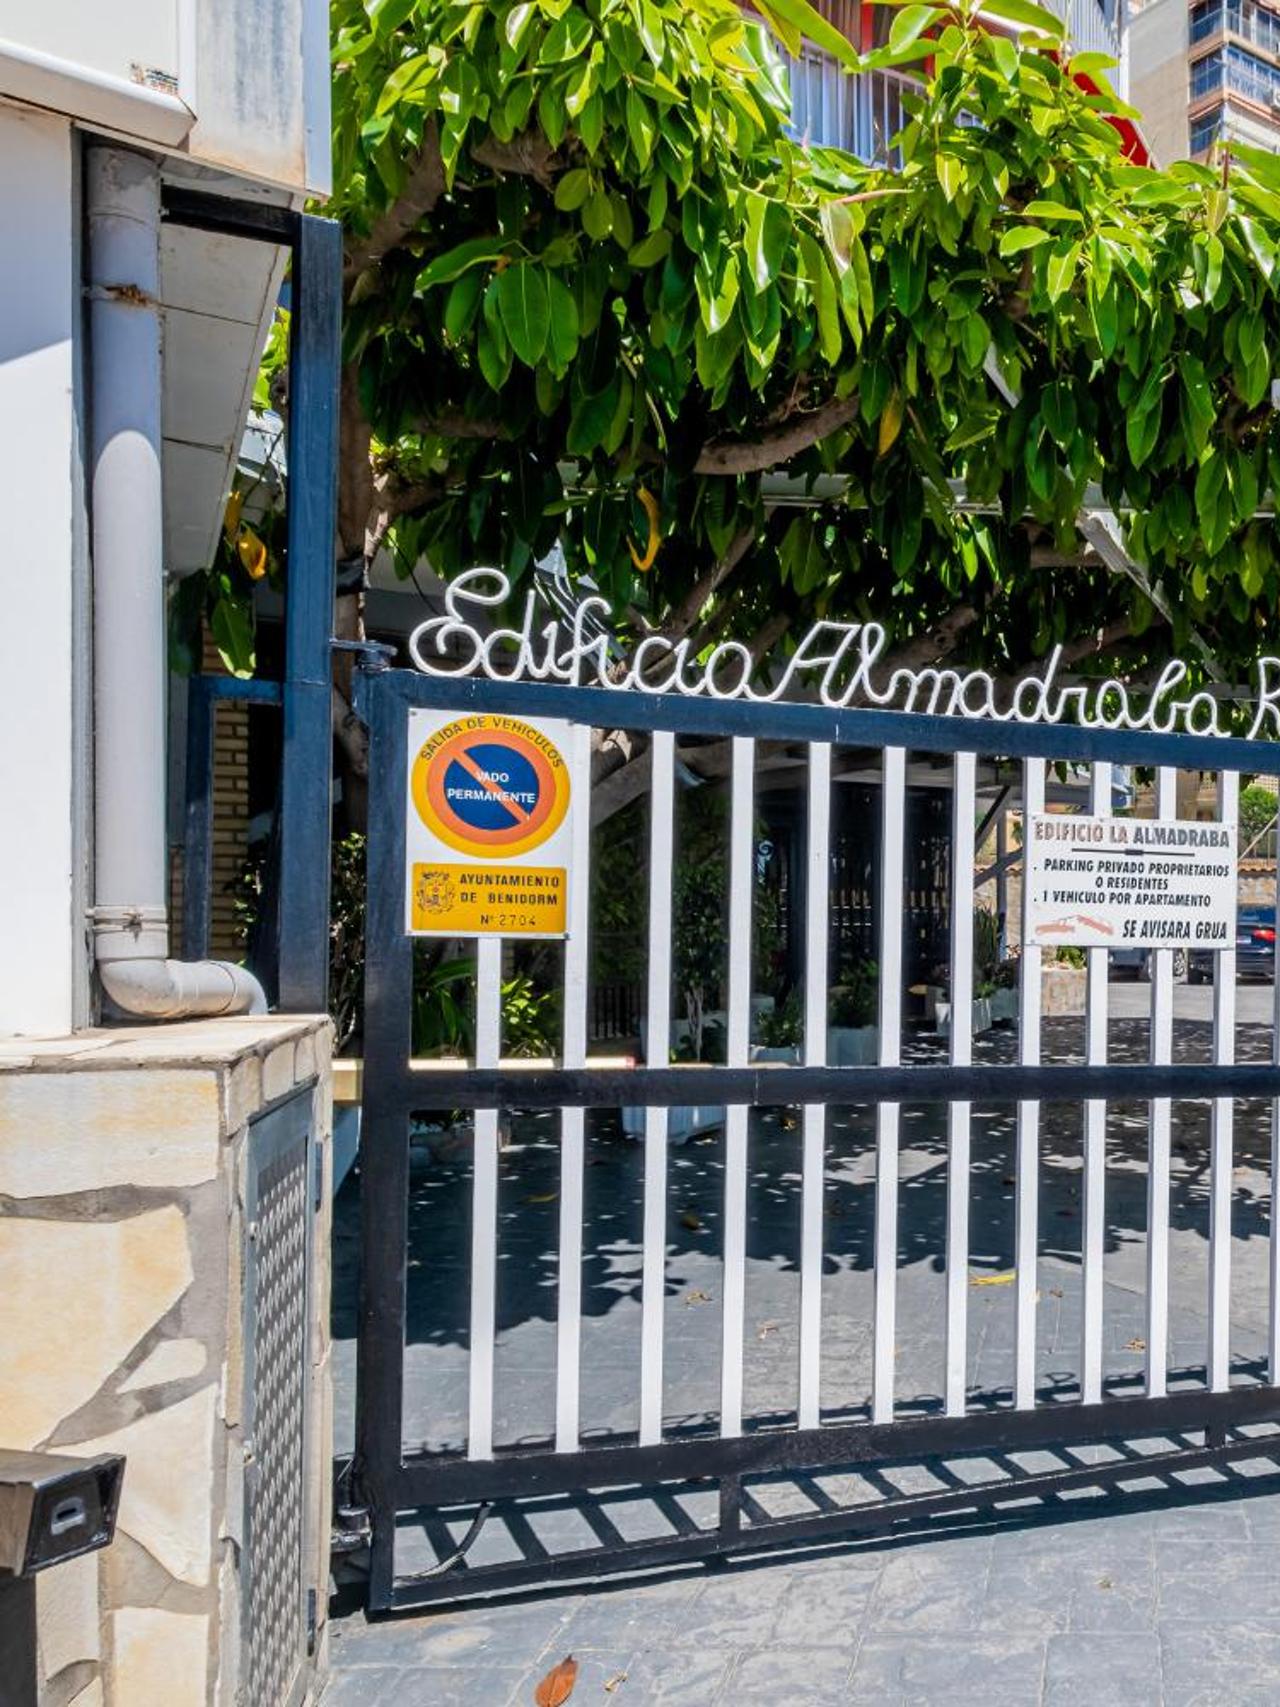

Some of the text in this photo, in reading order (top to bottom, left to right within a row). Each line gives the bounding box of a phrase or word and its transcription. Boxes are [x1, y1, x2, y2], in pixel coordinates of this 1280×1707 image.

[408, 567, 754, 700] Edificio
[750, 620, 1231, 737] Almadraba
[421, 716, 564, 768] SALIDA DE VEHICULOS
[476, 771, 510, 783] VADO
[447, 788, 536, 803] PERMANENTE
[1035, 821, 1230, 848] EDIFICIO LA ALMADRABA
[1044, 858, 1229, 877] PARKING PRIVADO PROPRIETARIOS
[460, 873, 560, 888] AYUNTAMIENTO
[1095, 876, 1169, 891] O RESIDENTES
[460, 892, 558, 905] DE BENIDORM
[1052, 890, 1105, 905] VEHICULO
[1109, 892, 1131, 906] POR
[1135, 893, 1211, 908] APARTAMENTO
[1122, 919, 1228, 940] SE AVISARA GRUA
